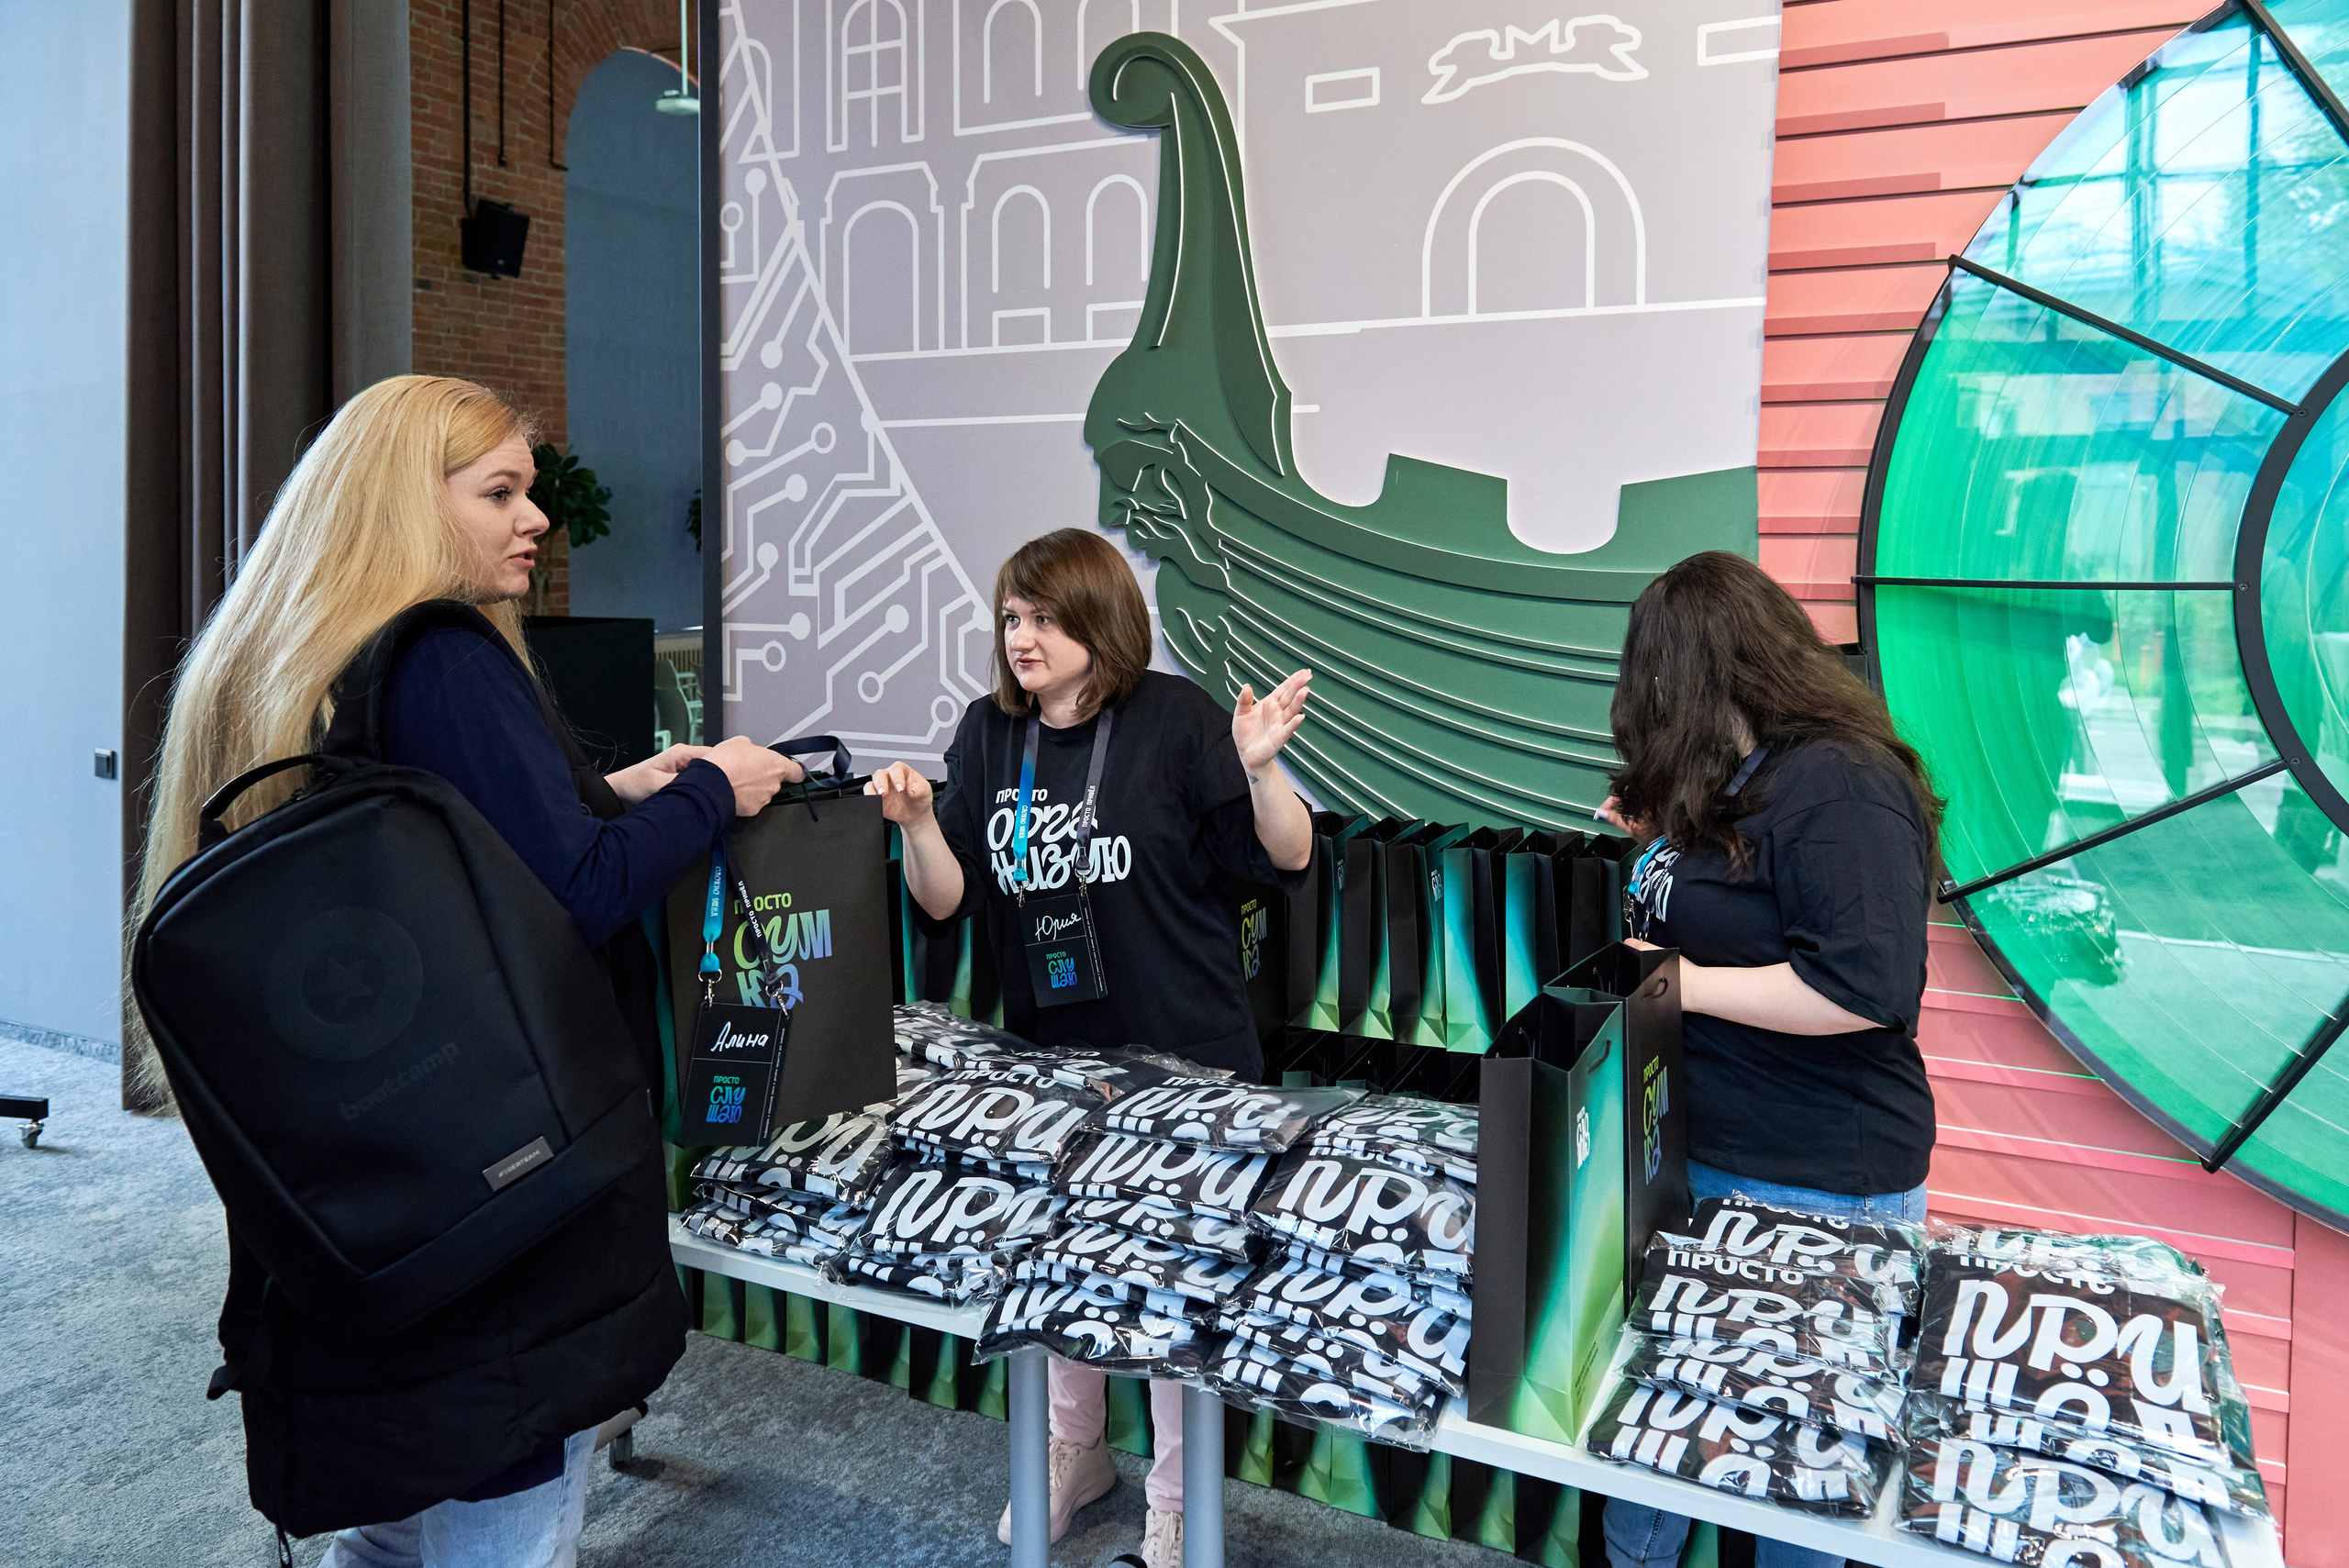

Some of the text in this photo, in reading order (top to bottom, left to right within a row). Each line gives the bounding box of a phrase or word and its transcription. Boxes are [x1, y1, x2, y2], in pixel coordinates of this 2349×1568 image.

[996, 788, 1048, 804] ПРОТО
[734, 892, 793, 915] ПОСТО
[1241, 898, 1257, 916] ПРОСТО
[749, 910, 763, 939] ПРОСТО
[1046, 951, 1067, 960] ПРОСТО
[710, 1020, 770, 1052] Алина
[713, 1075, 740, 1085] ПРОСТО
[1667, 1250, 1804, 1285] ПРОСТО
